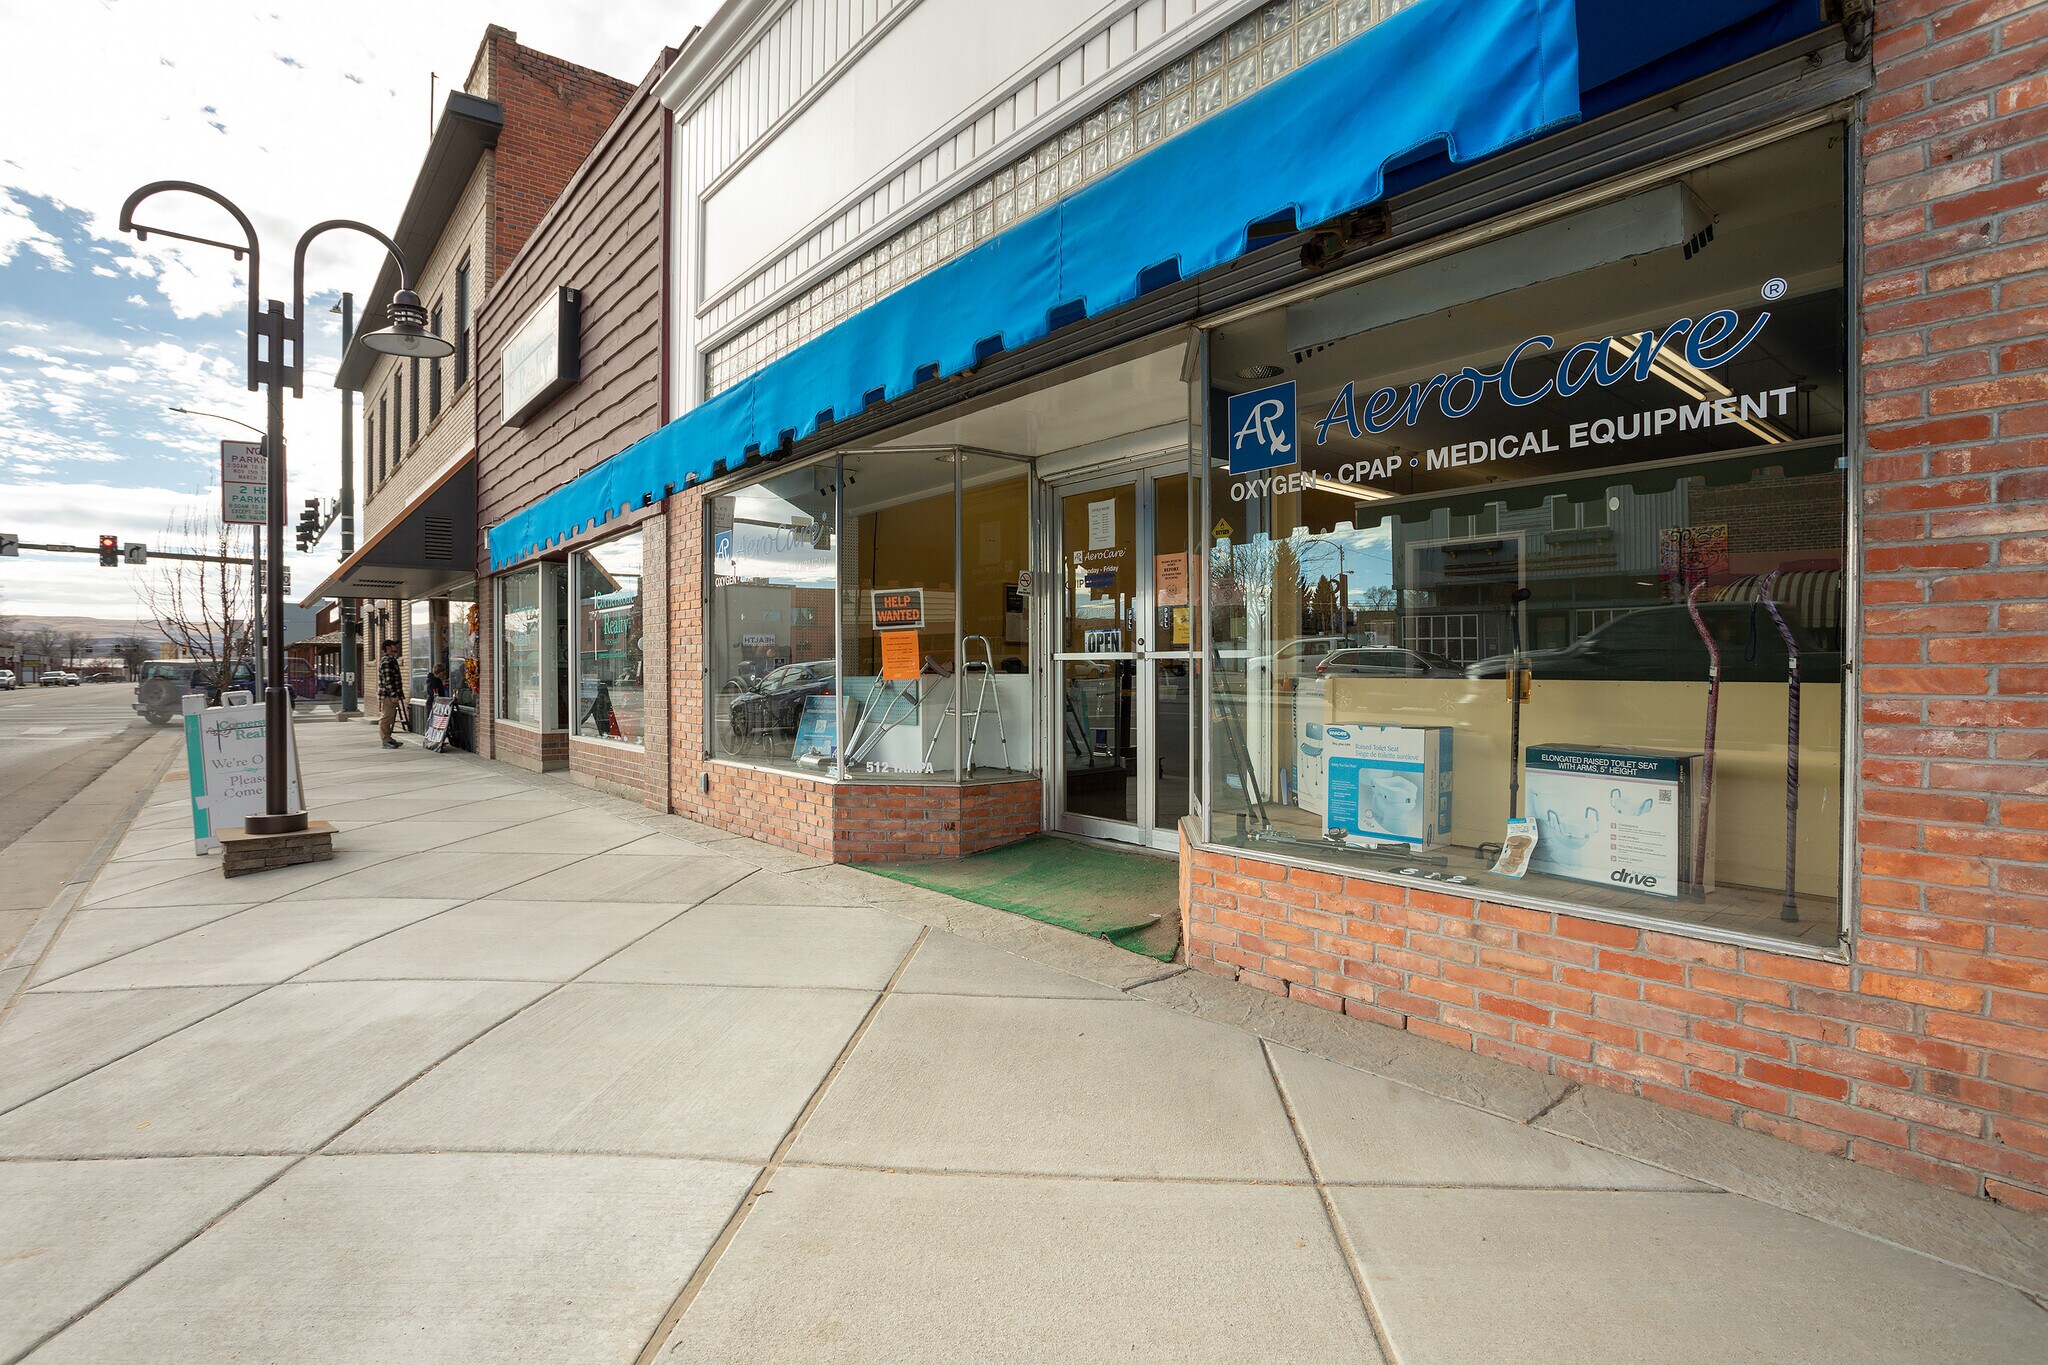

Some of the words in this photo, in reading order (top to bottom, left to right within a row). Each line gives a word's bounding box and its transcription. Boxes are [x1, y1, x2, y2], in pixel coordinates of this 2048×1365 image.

[1313, 308, 1772, 446] AeroCare
[1230, 469, 1317, 502] OXYGEN
[1338, 455, 1402, 485] CPAP
[1426, 428, 1559, 471] MEDICAL
[1569, 386, 1797, 449] EQUIPMENT
[232, 456, 266, 464] PARKI
[240, 486, 247, 494] 2
[232, 495, 266, 503] PARKI
[736, 521, 824, 557] AeroCare
[1084, 550, 1125, 561] AeroCare
[715, 576, 736, 587] OXYGEN
[884, 595, 911, 608] HELP
[877, 609, 920, 622] WANTED
[604, 612, 628, 637] Realty
[1088, 633, 1120, 652] OPEN
[235, 728, 266, 740] Real
[212, 758, 248, 768] We're
[866, 762, 889, 773] 512
[1542, 754, 1582, 764] ELONGATED
[1583, 757, 1609, 766] RAISED
[1610, 759, 1637, 768] TOILET
[1638, 761, 1658, 770] SEAT
[1609, 767, 1638, 776] HEIGHT
[224, 788, 262, 798] Come
[1611, 869, 1657, 887] drive
